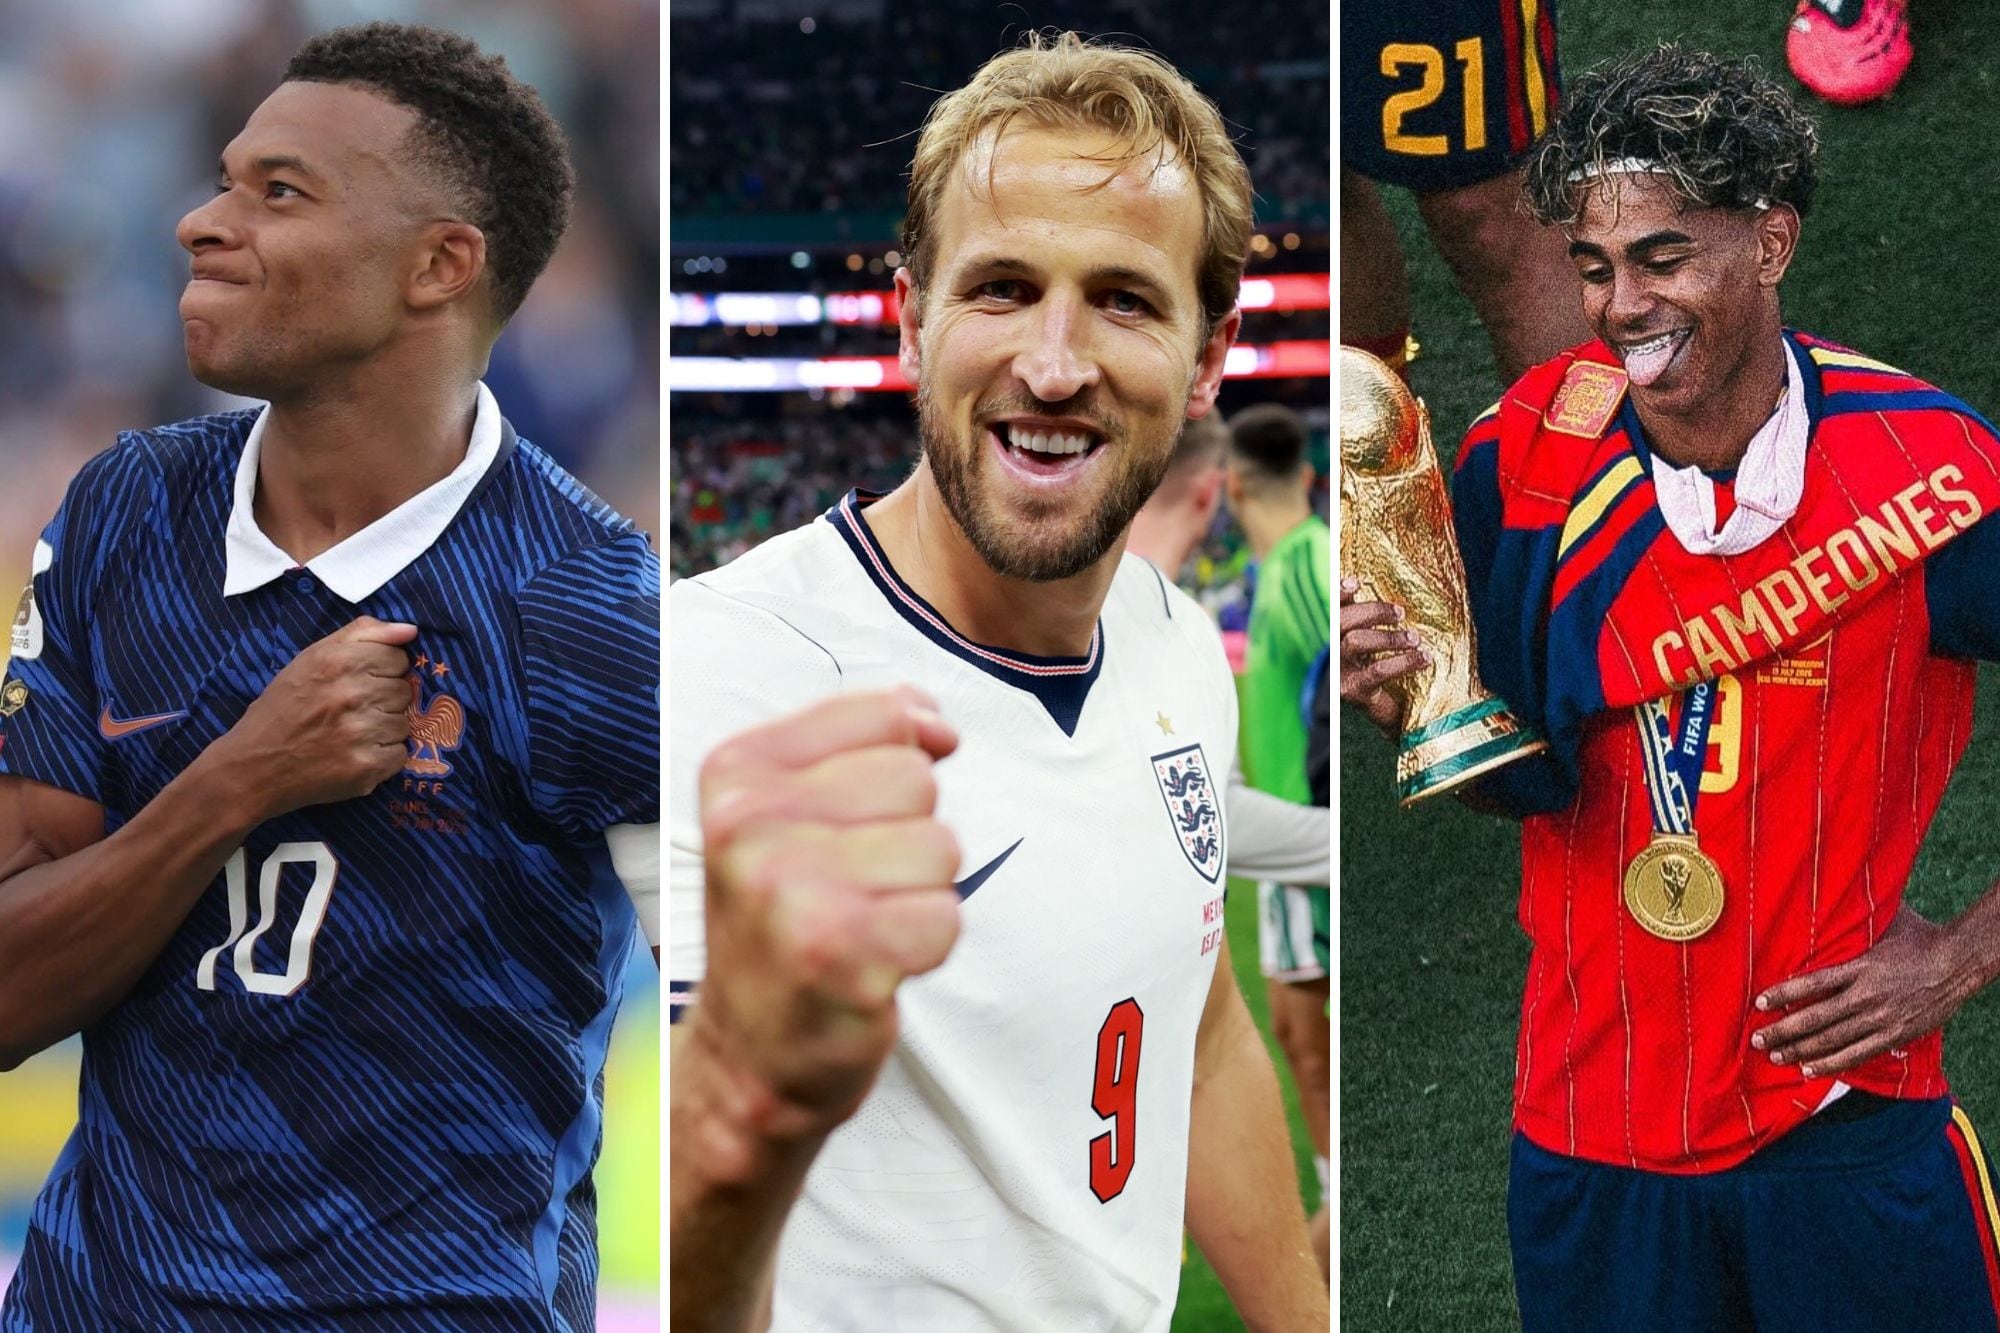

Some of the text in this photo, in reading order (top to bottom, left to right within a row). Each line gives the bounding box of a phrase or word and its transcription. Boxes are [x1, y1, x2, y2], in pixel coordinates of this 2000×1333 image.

[1380, 36, 1486, 155] 21
[1651, 463, 1983, 691] CAMPEONES
[403, 778, 444, 796] FFF
[1682, 716, 1703, 757] FIFA
[196, 840, 340, 997] 10
[1088, 996, 1144, 1204] 9
